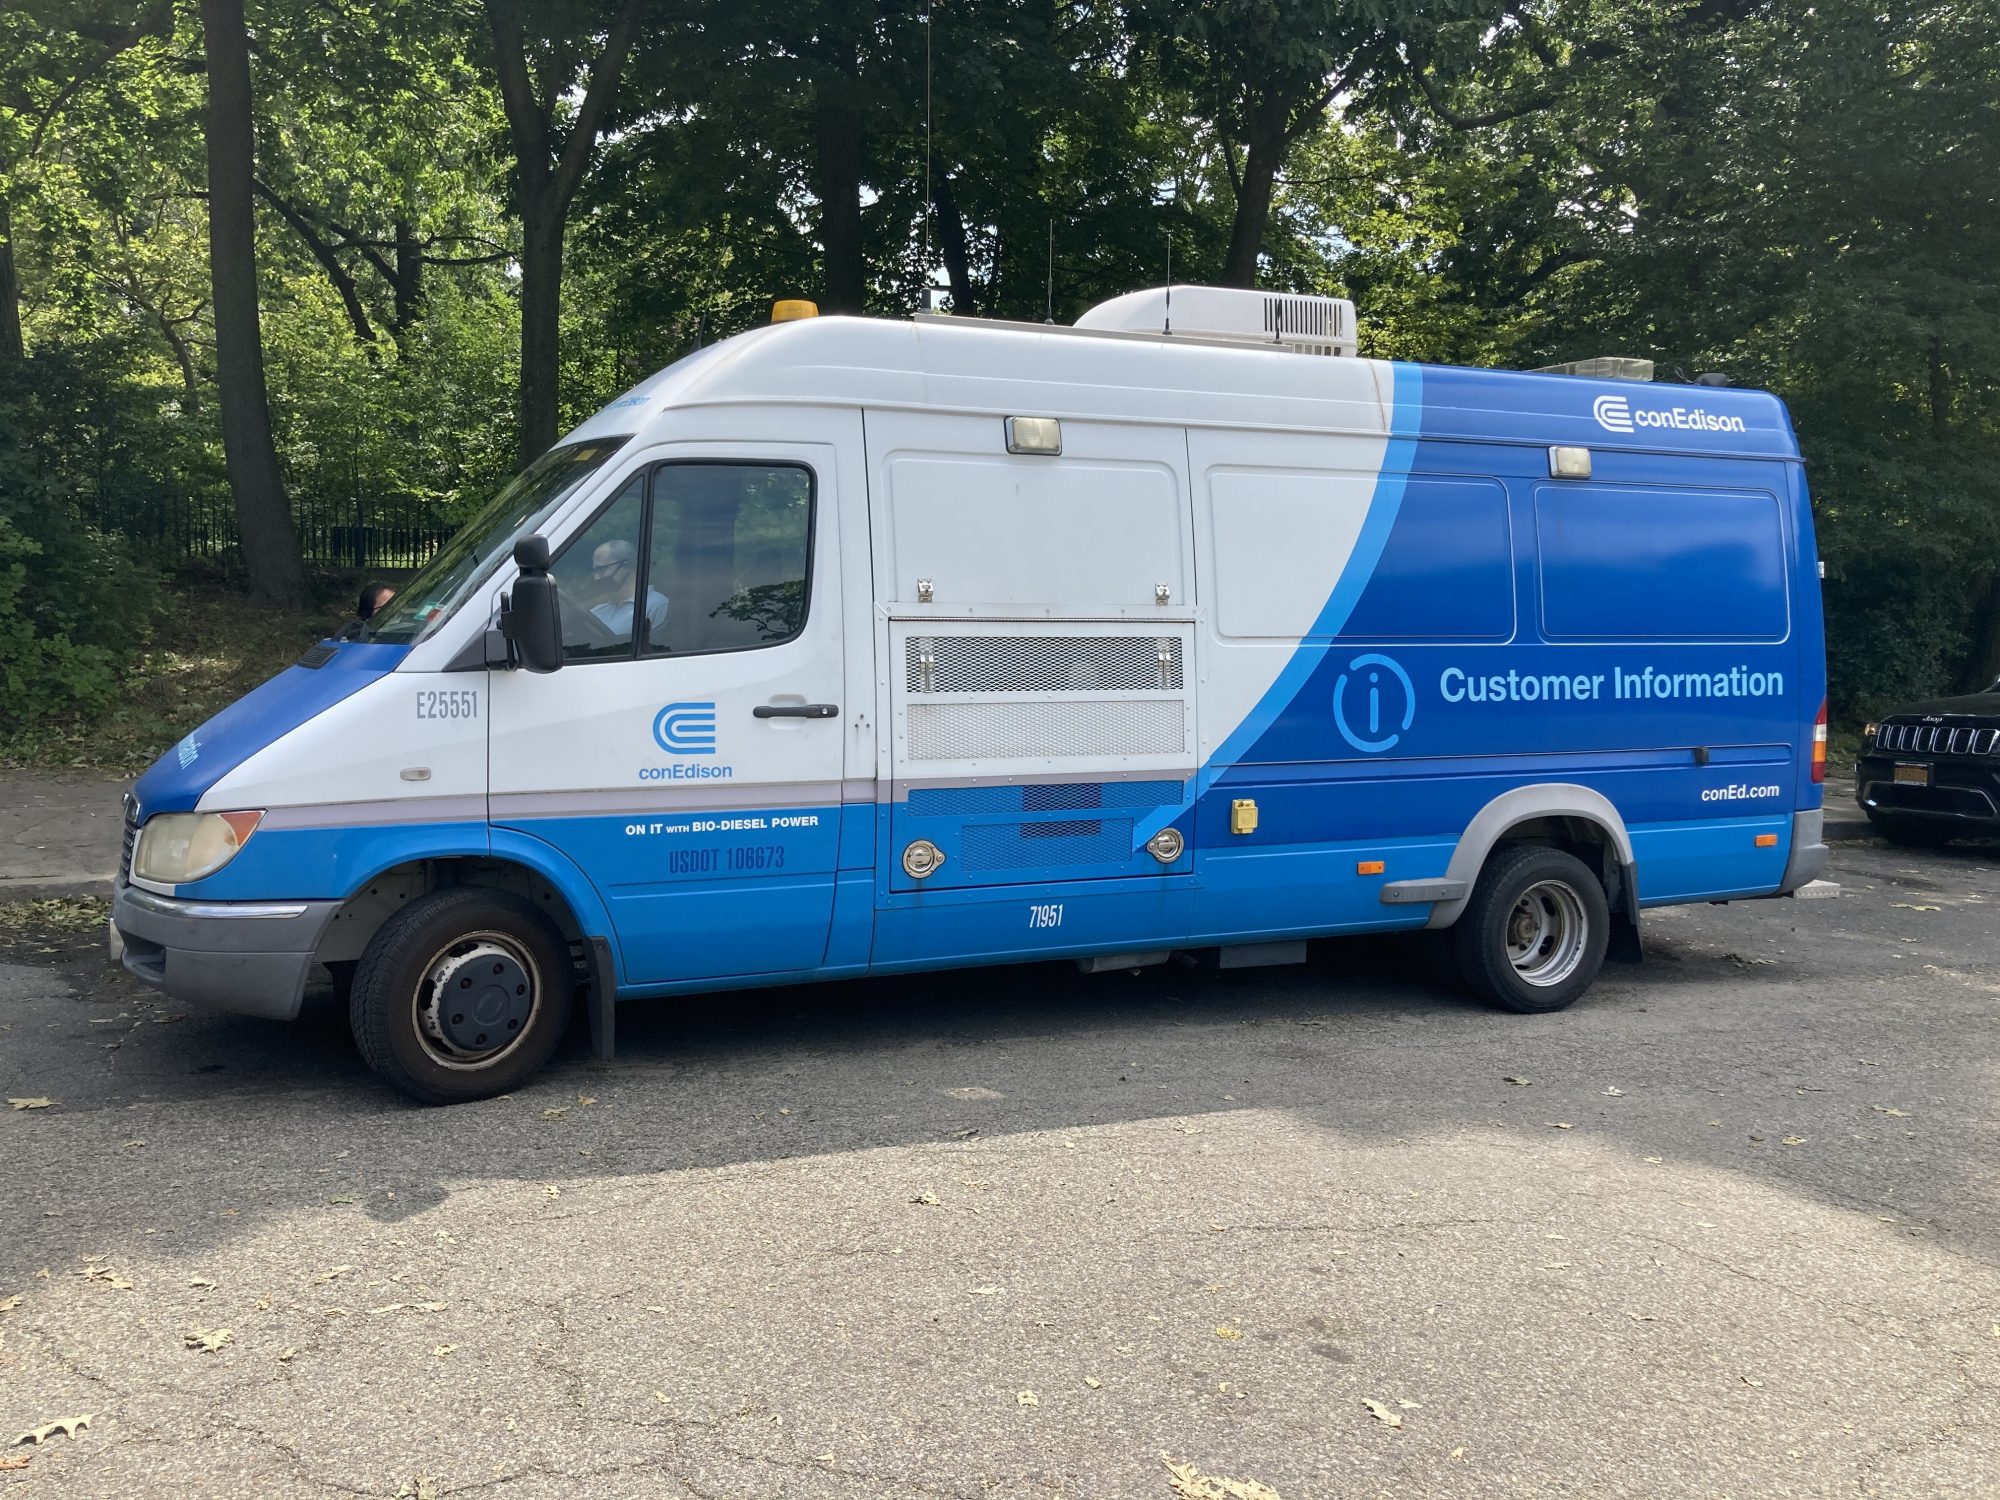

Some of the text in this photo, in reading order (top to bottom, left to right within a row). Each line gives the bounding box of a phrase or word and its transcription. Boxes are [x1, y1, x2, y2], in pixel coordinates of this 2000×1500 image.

[1634, 407, 1746, 433] conEdison
[1439, 665, 1784, 703] Customer Information
[416, 690, 478, 719] E25551
[638, 763, 733, 780] conEdison
[1701, 783, 1780, 802] conEd.com
[625, 815, 819, 836] ON IT WITH BIO-DIESEL POWER
[669, 845, 785, 874] USDOT 106673
[1029, 904, 1064, 928] 71951
